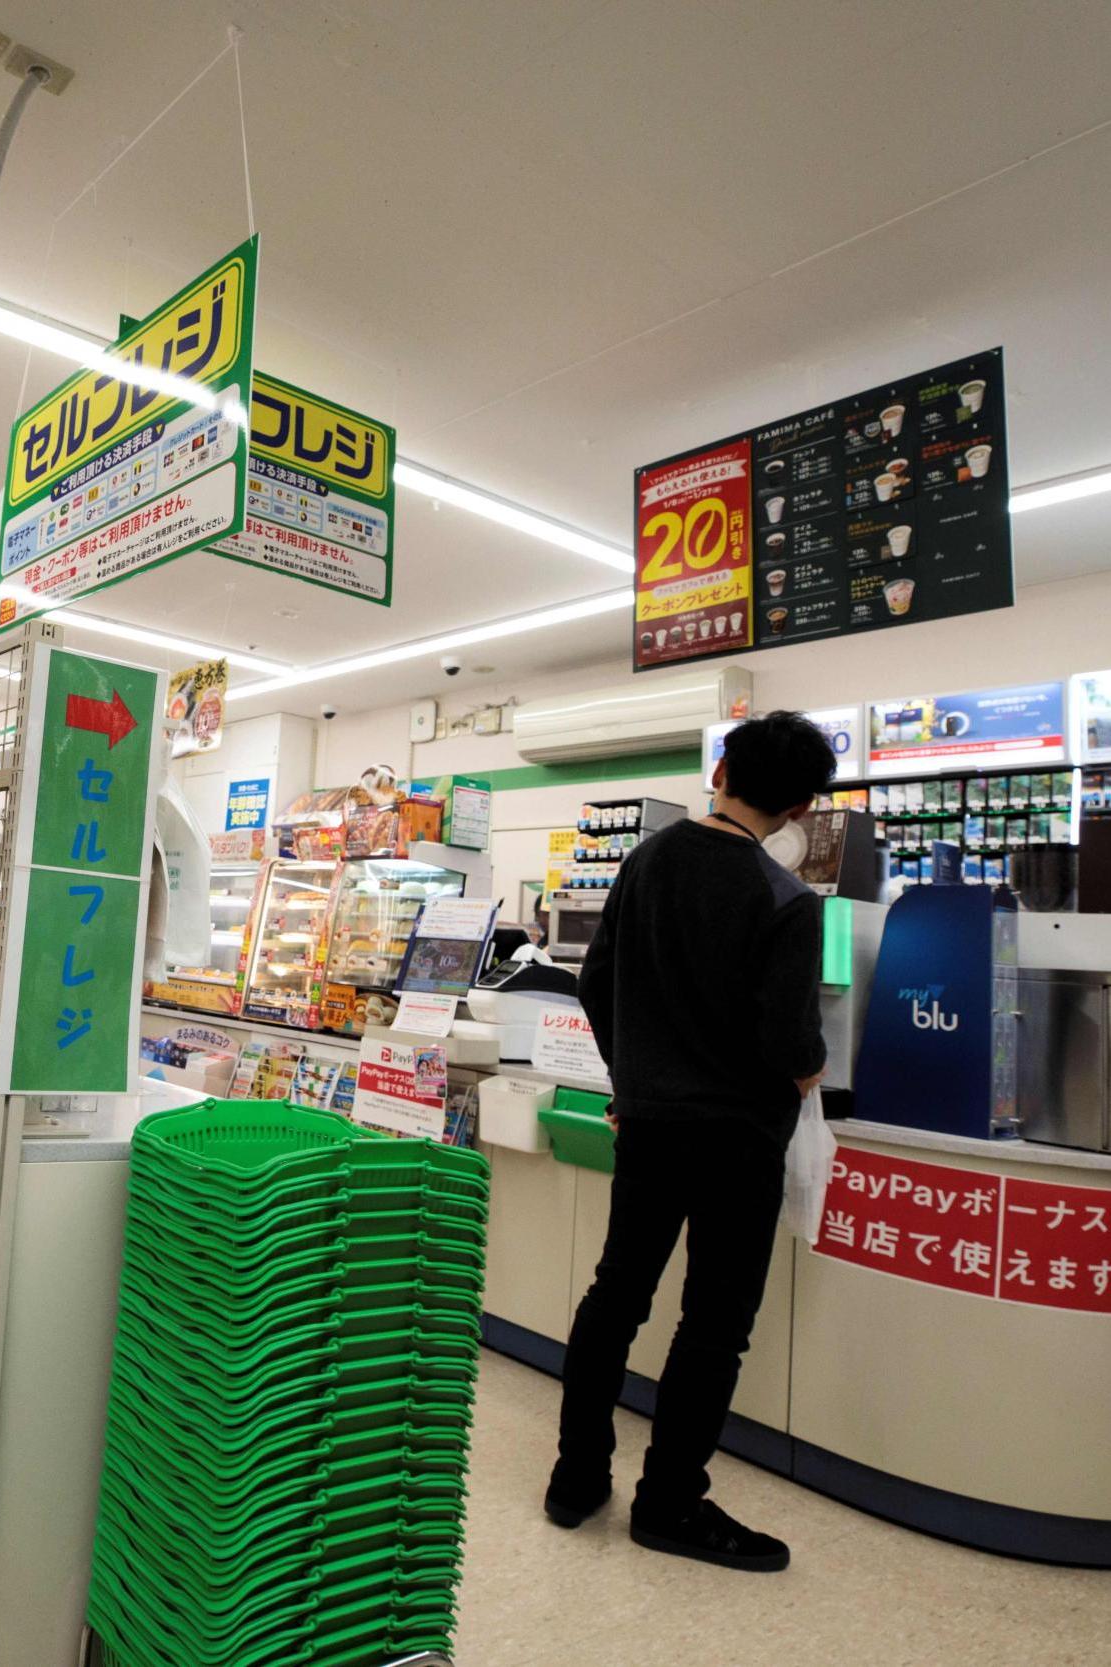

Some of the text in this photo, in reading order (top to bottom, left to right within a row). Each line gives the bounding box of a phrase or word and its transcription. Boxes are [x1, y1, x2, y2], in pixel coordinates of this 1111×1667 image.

[23, 280, 226, 483] セルフレジ
[757, 408, 835, 442] FAMIMA CAFÉ
[61, 429, 153, 492] ご利用頂ける決済手段
[8, 546, 31, 566] ポイント
[24, 494, 192, 584] 現金・クーポン等はご利用頂けません。
[641, 498, 728, 584] 20
[641, 582, 744, 616] クーポンプレゼント
[56, 758, 114, 1051] セルフレジ
[898, 987, 929, 1007] my
[911, 999, 959, 1032] blu
[175, 1028, 231, 1049] まるみのあるコク
[826, 1160, 1109, 1233] PayPayボーナス
[825, 1210, 1111, 1295] 当店で使えます
